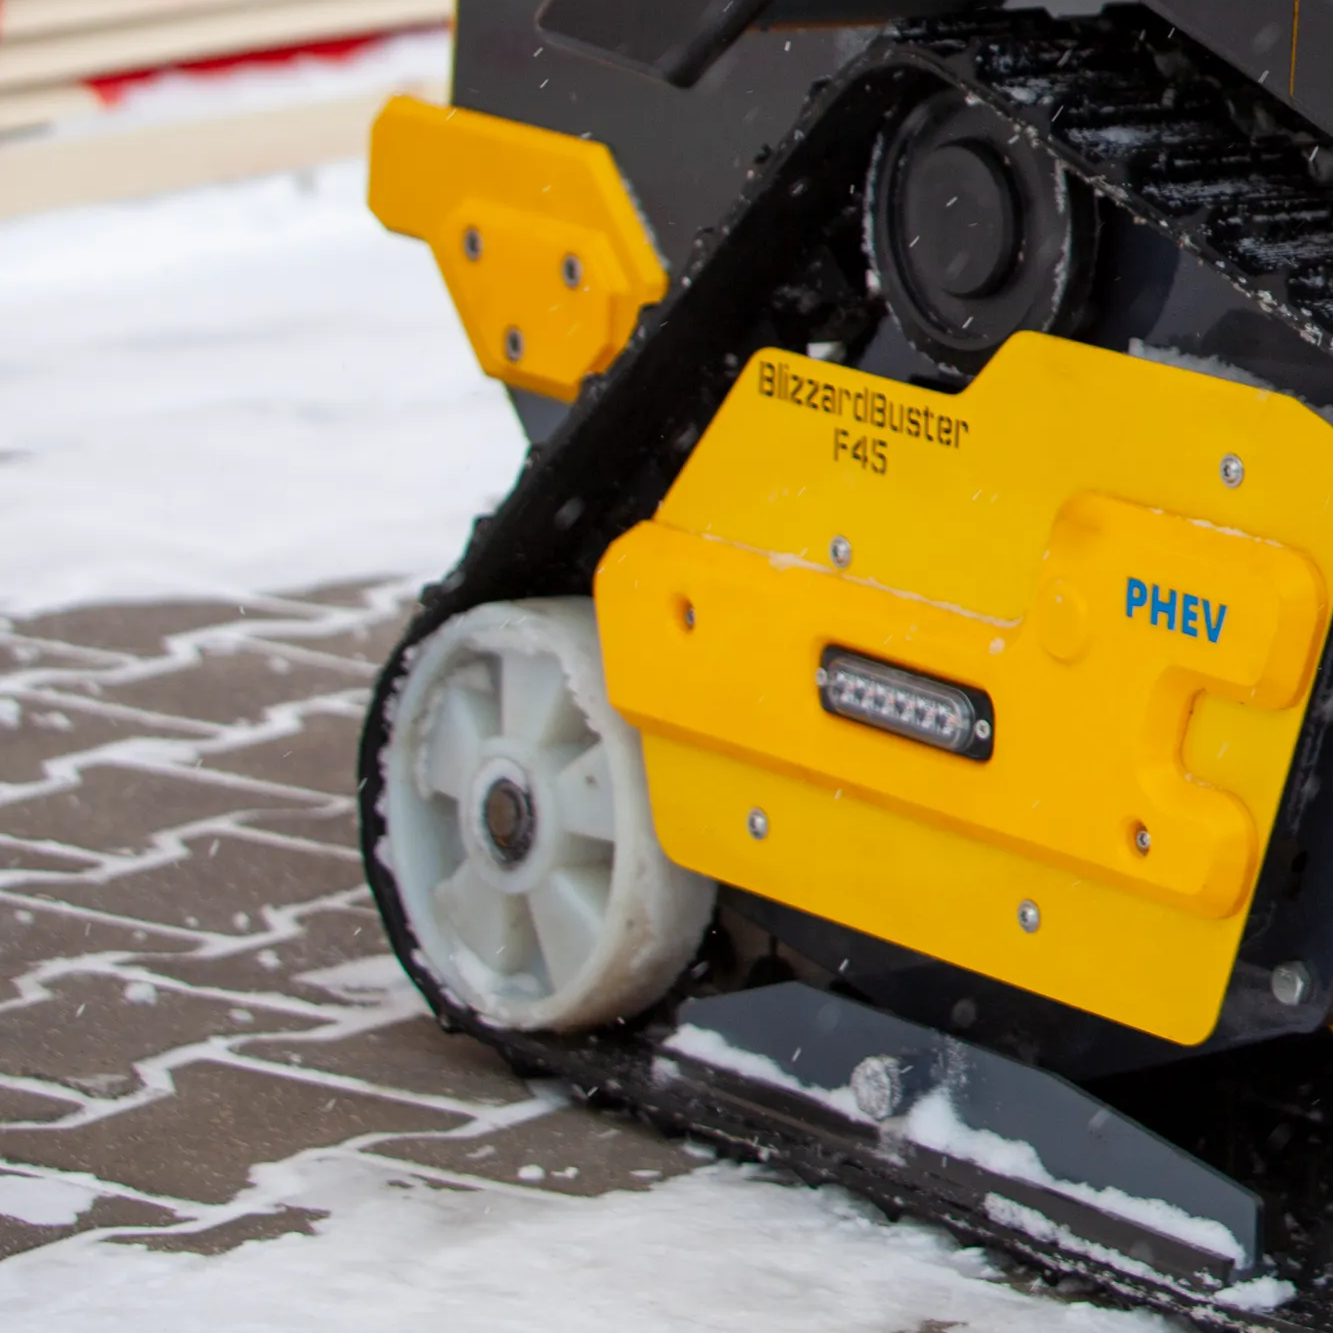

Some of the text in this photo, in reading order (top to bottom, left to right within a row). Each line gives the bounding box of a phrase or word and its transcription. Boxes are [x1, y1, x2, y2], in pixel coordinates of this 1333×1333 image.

[759, 361, 969, 449] BlizzardBuster
[833, 427, 888, 475] F45
[1126, 576, 1228, 643] PHEV
